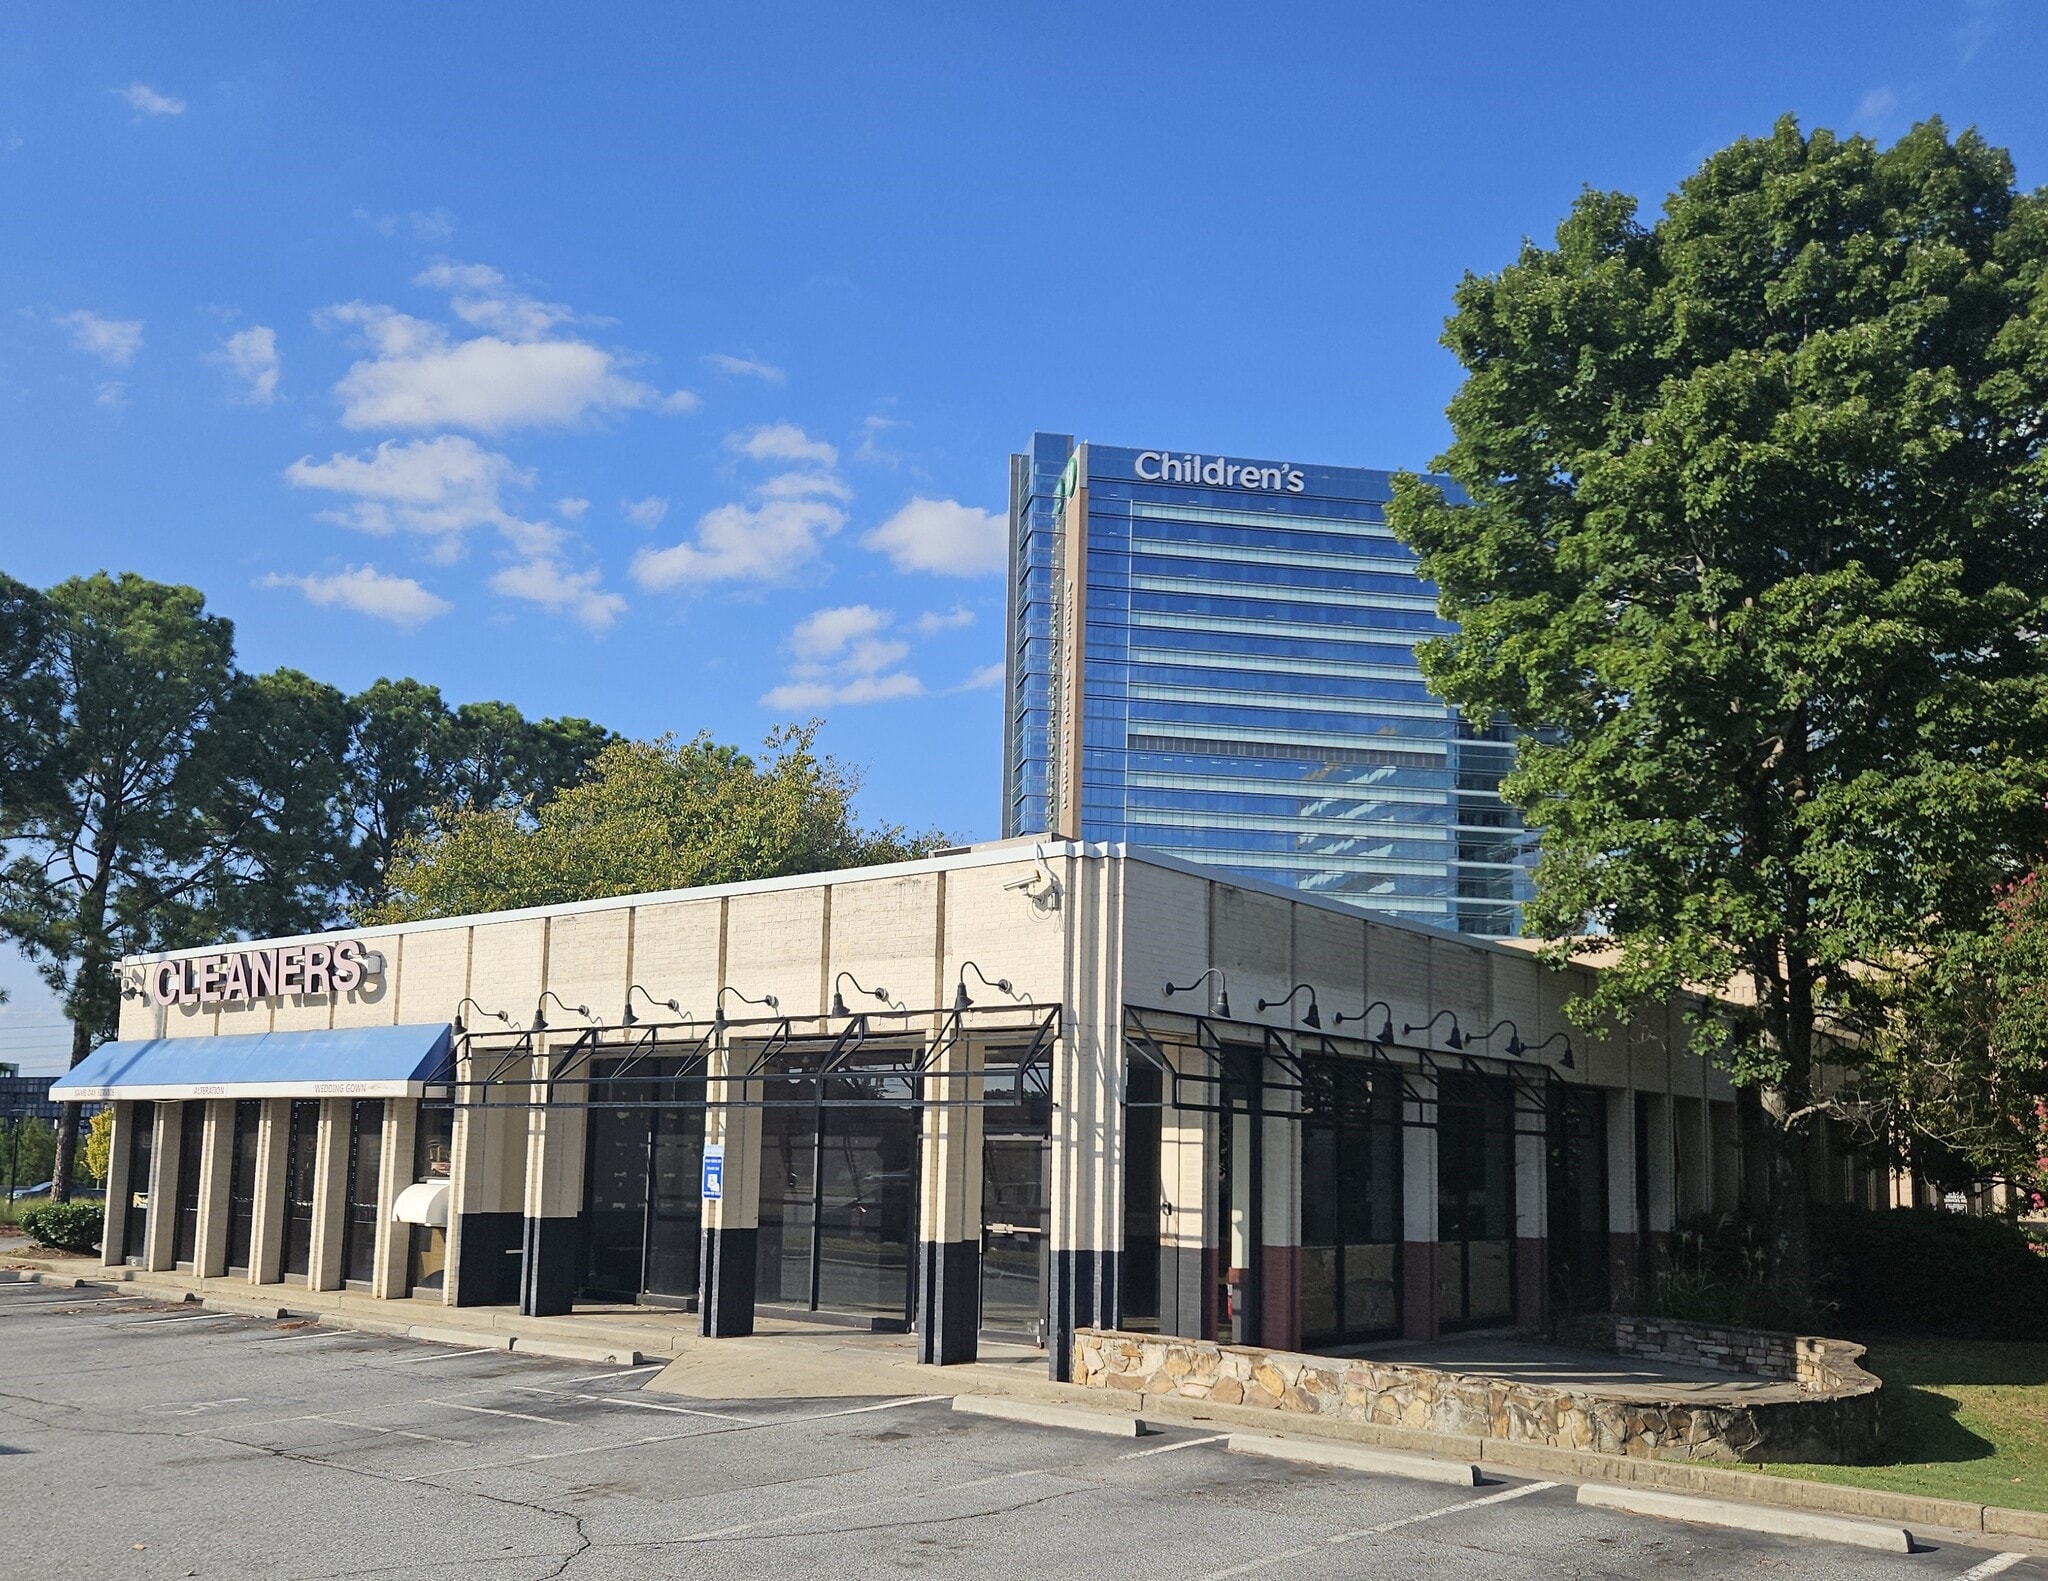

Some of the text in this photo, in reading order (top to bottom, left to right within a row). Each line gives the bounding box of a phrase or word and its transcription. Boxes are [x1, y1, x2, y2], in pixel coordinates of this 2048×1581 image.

[1134, 451, 1305, 493] Children's
[153, 940, 364, 1006] CLEANERS
[193, 1086, 225, 1095] ALTERATION
[314, 1084, 367, 1094] WEDDING GOWN
